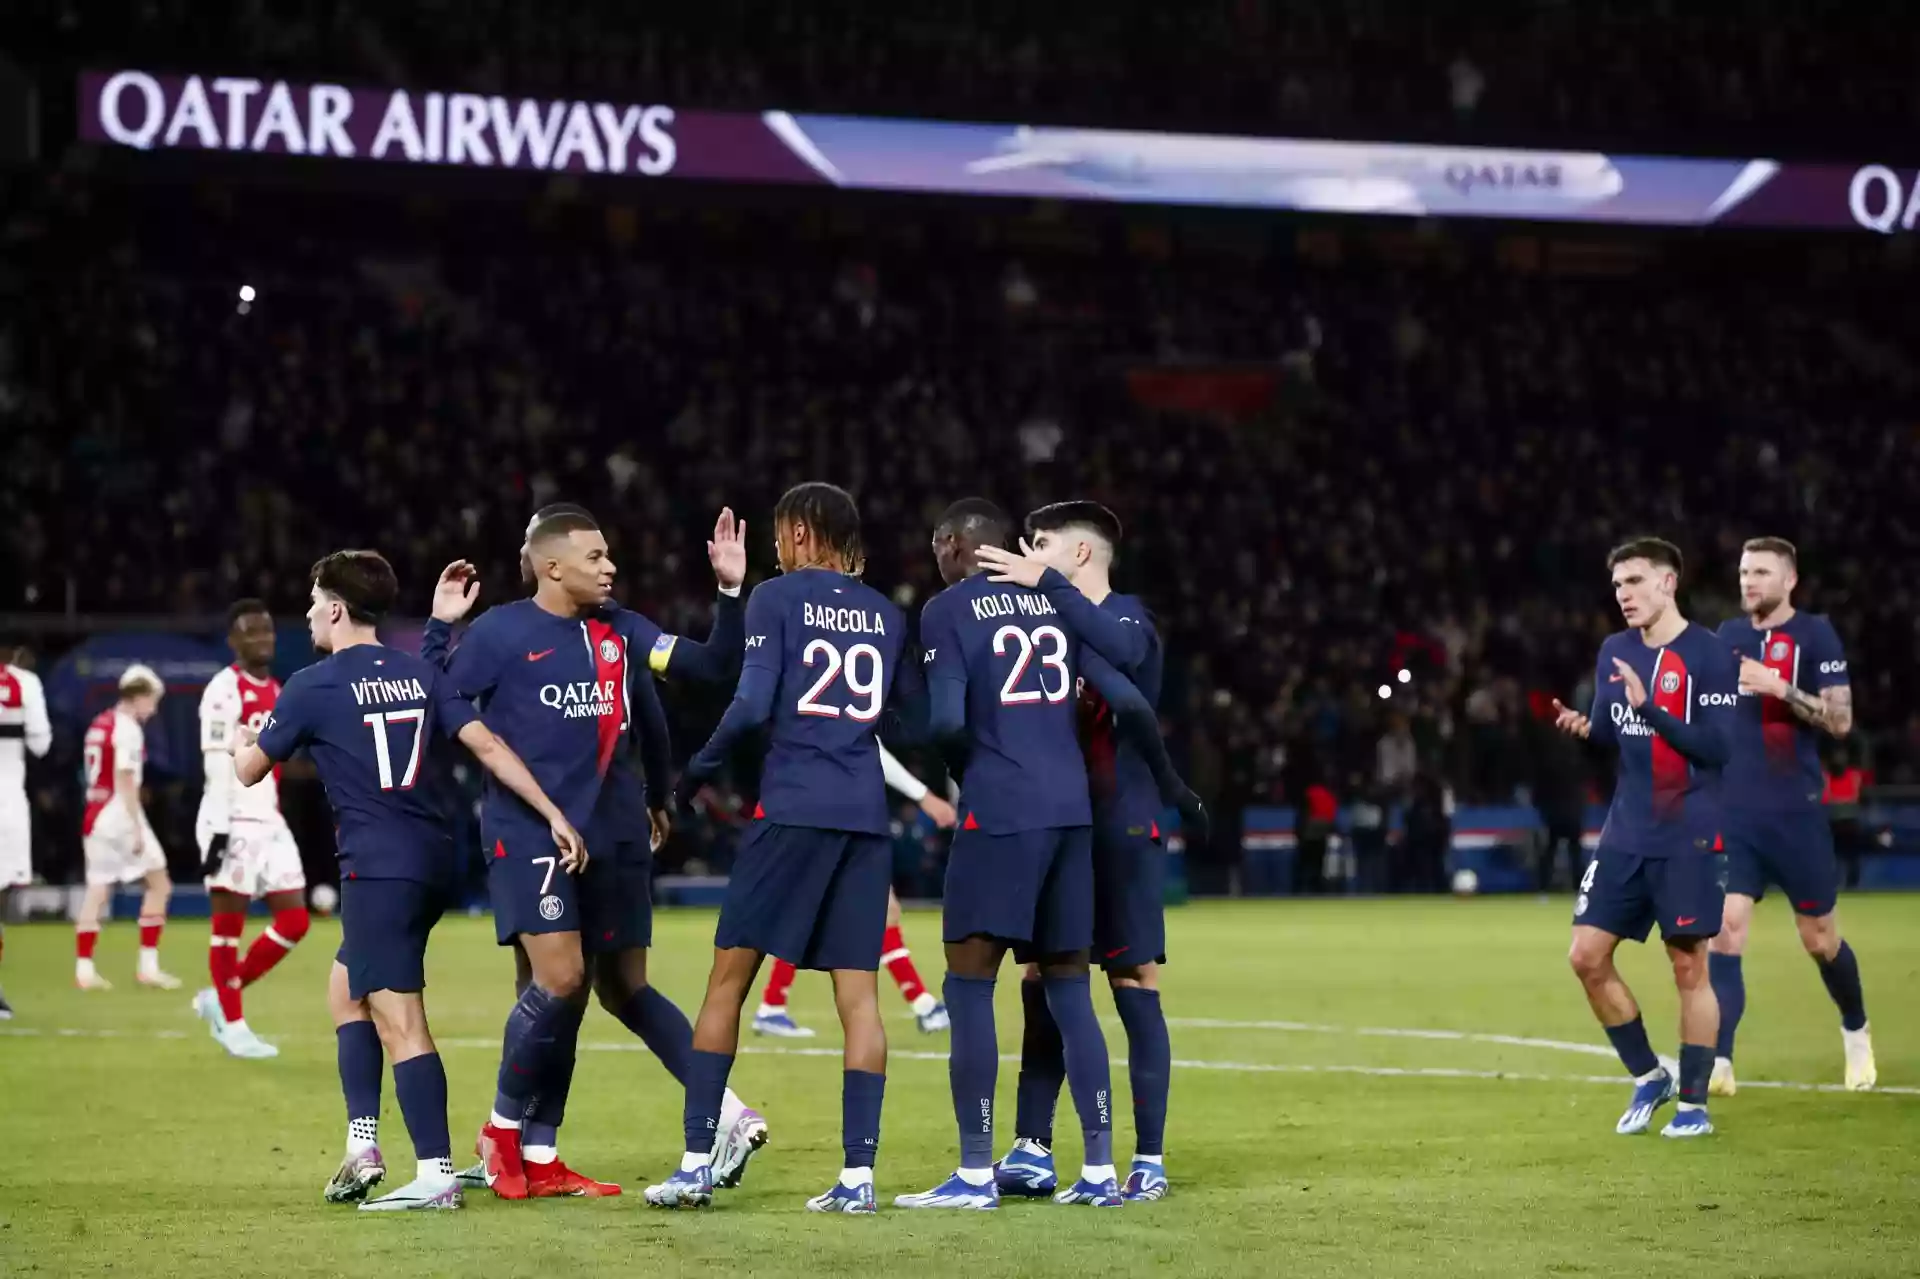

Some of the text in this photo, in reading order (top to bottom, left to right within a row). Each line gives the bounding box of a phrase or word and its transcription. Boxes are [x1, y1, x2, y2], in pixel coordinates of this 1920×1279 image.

[99, 70, 677, 176] QATAR AIRWAYS
[803, 601, 885, 636] BARCOLA
[971, 593, 1057, 620] KOLO MUA
[797, 638, 883, 722] 29
[993, 625, 1070, 705] 23
[540, 680, 615, 710] QATAR
[563, 702, 614, 719] AIRWAYS
[1699, 693, 1737, 706] GOAT
[364, 708, 425, 791] 17
[532, 856, 556, 894] 7
[980, 1098, 991, 1133] PARIS
[1096, 1090, 1109, 1124] PARIS
